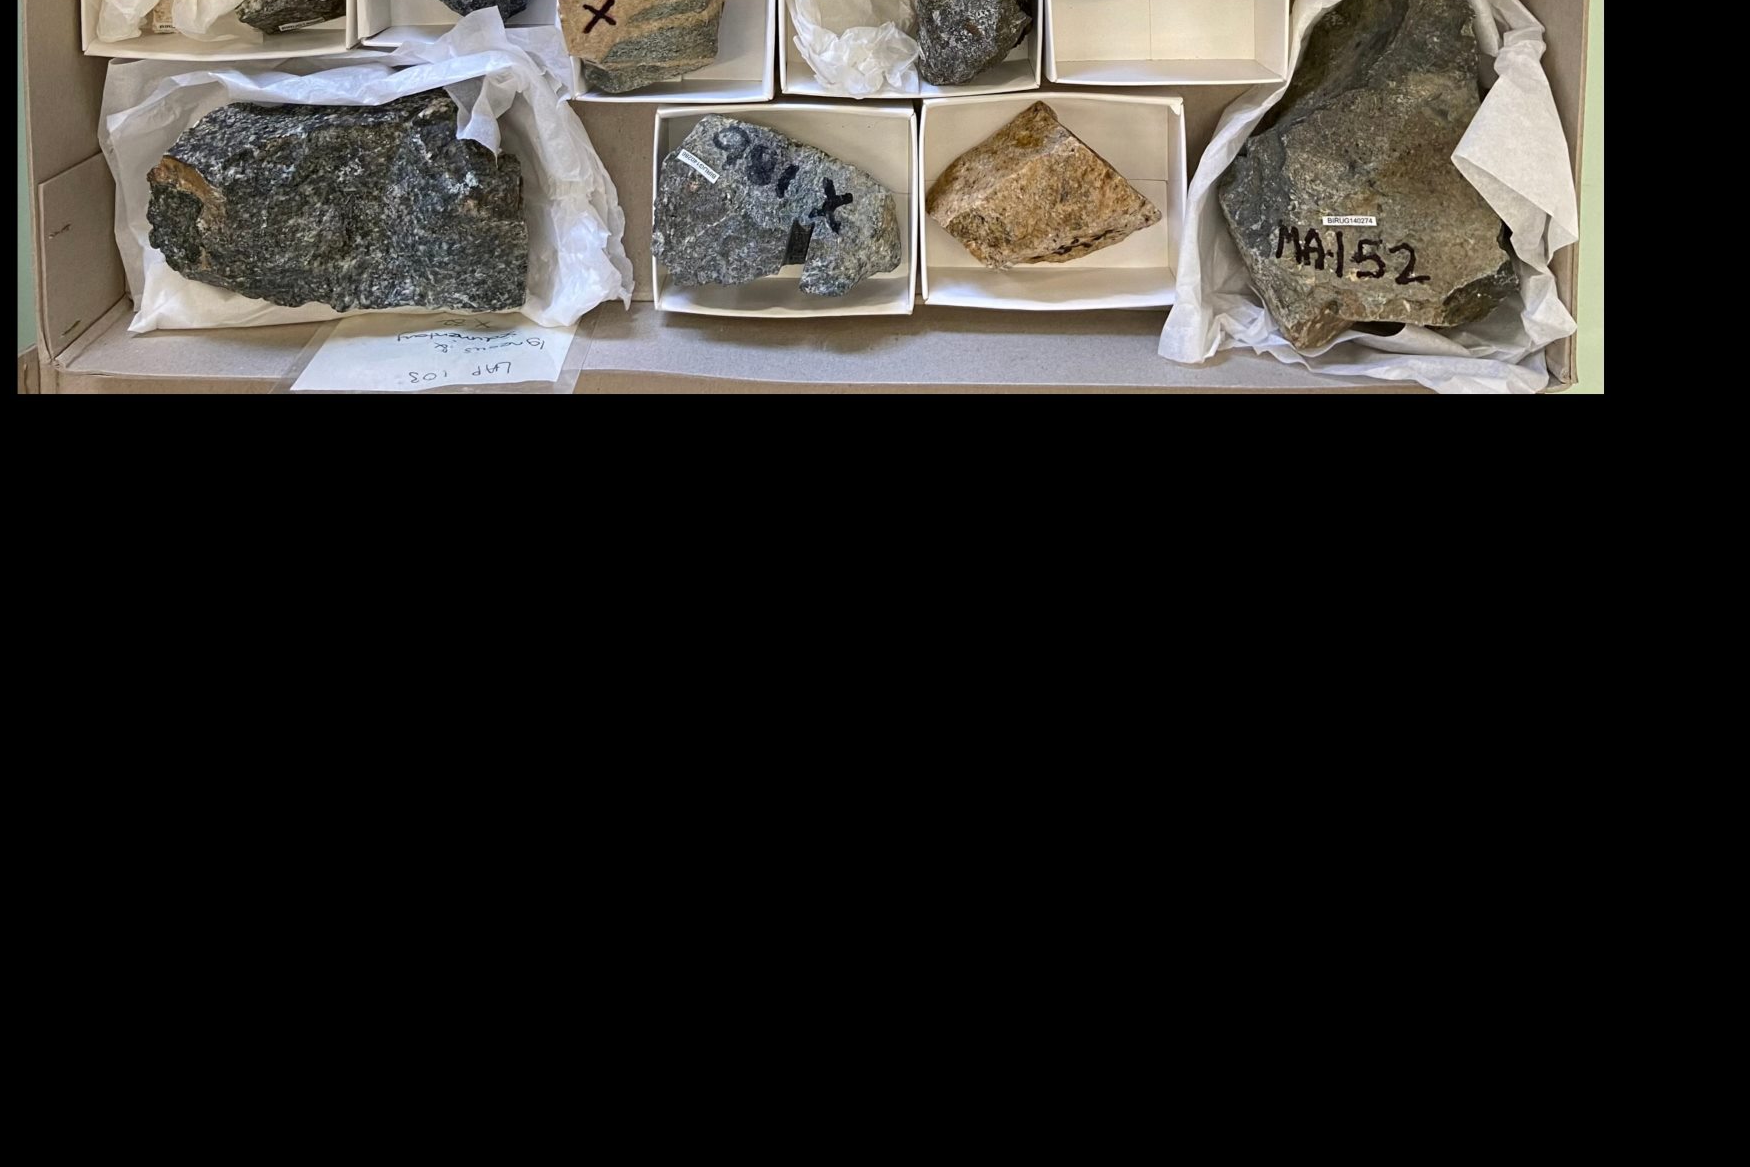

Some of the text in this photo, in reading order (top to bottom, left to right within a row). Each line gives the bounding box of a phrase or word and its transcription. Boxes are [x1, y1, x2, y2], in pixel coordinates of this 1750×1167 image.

[809, 176, 854, 233] X
[1327, 217, 1373, 225] BIRUG140274
[471, 362, 512, 377] LAP
